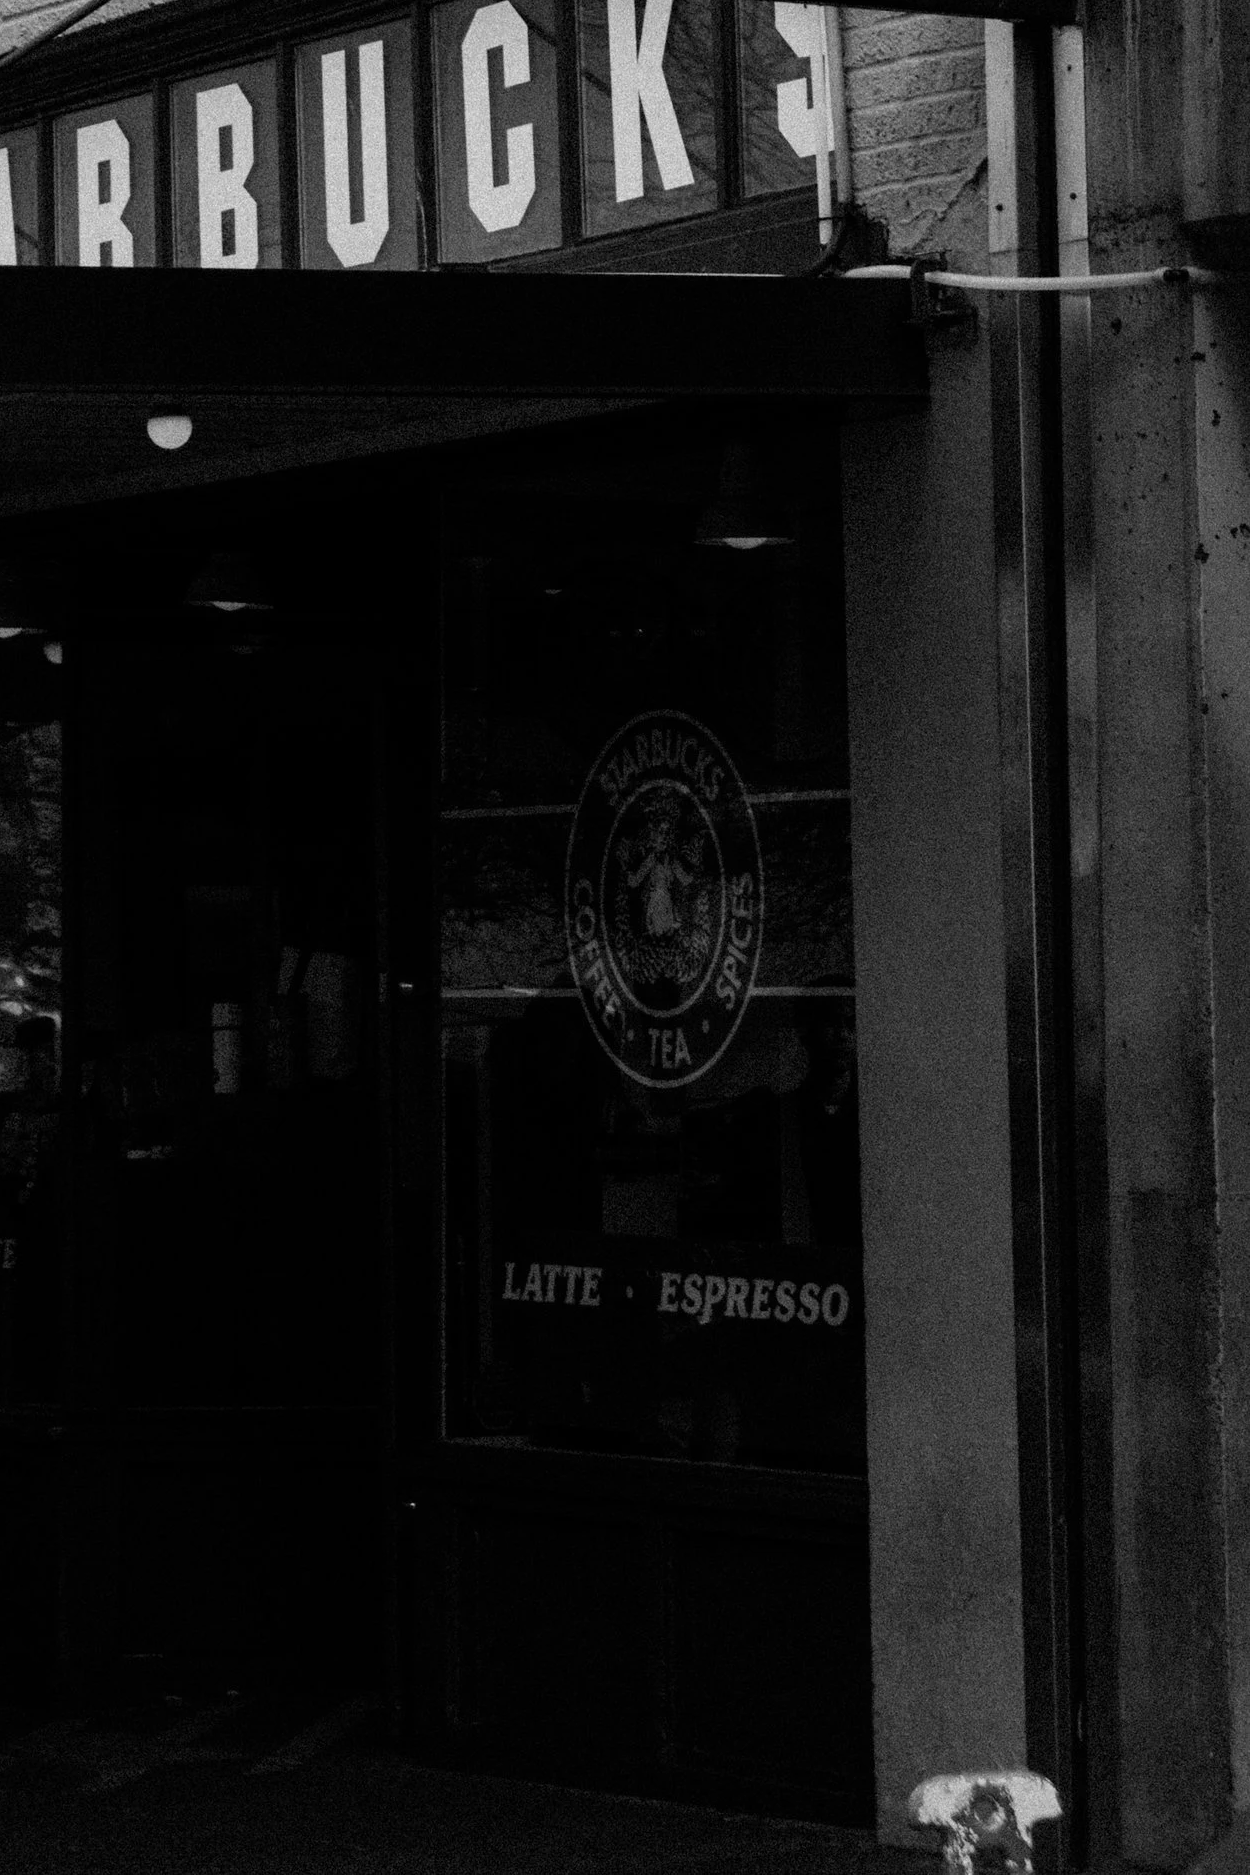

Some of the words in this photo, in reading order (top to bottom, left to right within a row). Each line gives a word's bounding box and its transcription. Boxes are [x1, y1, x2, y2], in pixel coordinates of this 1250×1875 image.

[598, 728, 727, 809] STARBUCKS
[571, 876, 626, 1033] COFFEE
[646, 1025, 693, 1070] TEA
[714, 870, 756, 1013] SPICES
[502, 1260, 604, 1308] LATTE
[656, 1270, 850, 1327] ESPRESSO
